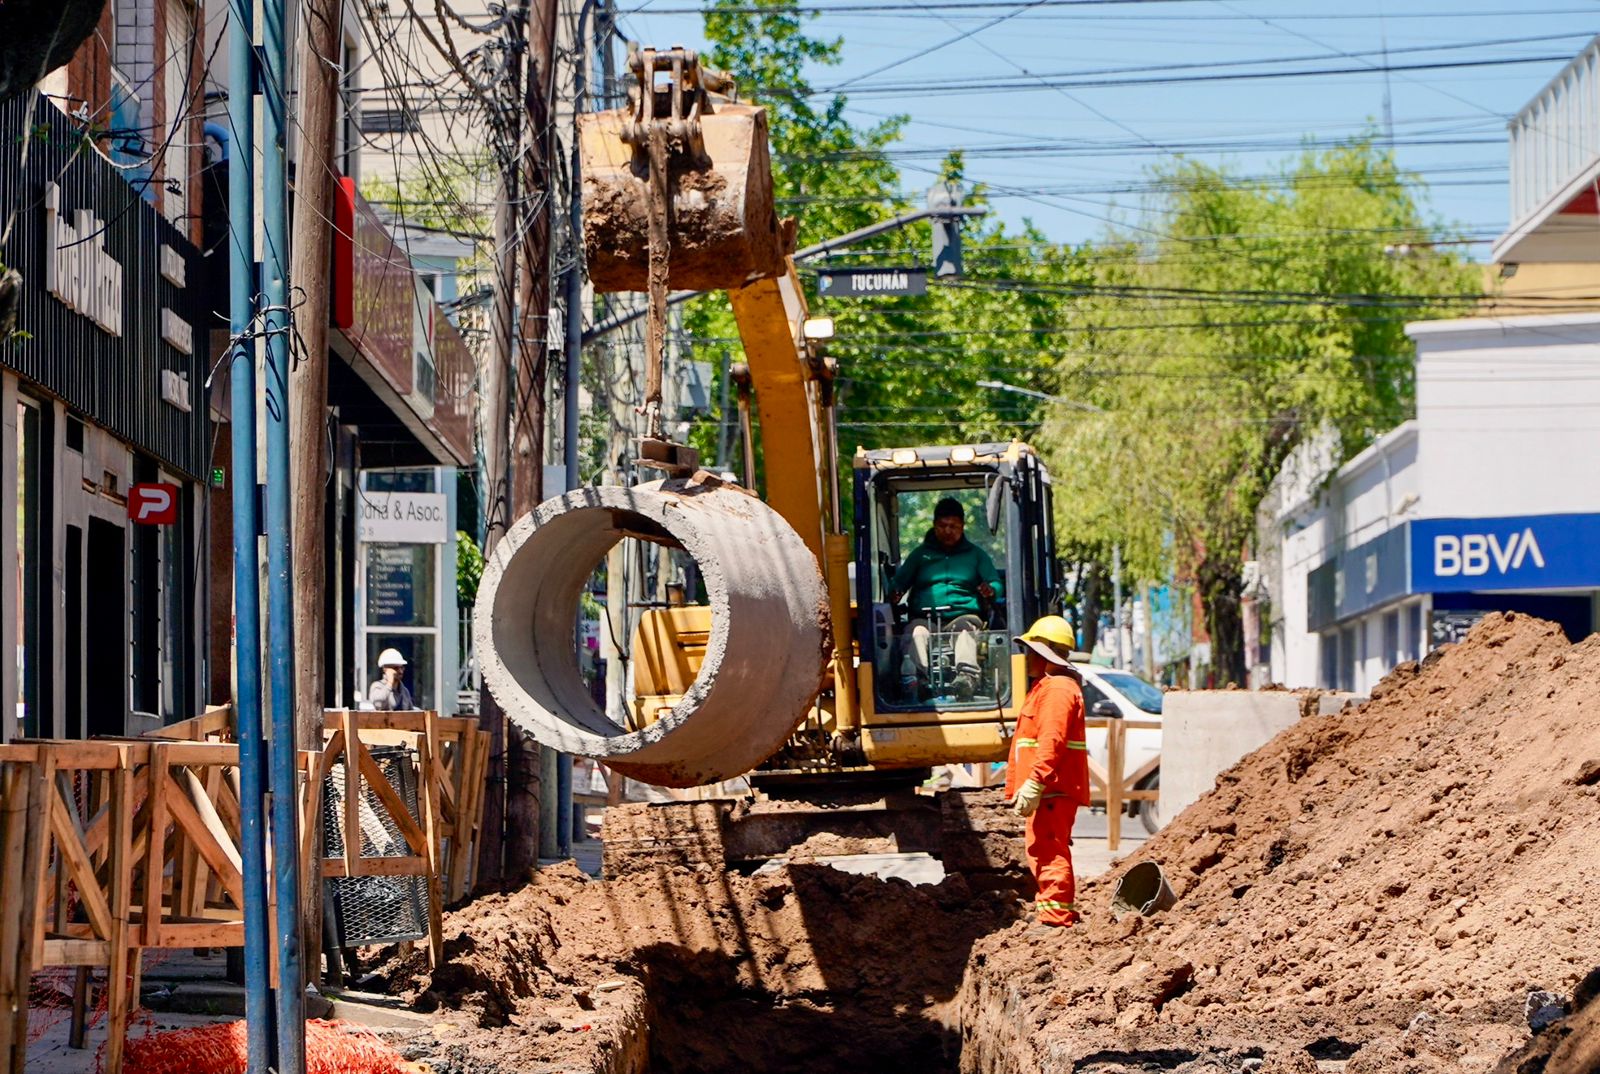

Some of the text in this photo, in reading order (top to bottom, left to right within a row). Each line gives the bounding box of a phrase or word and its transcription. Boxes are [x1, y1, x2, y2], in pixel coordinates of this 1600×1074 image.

[851, 270, 908, 291] TUCUMÁN
[394, 500, 403, 520] &
[407, 500, 443, 521] Asoc.
[1434, 527, 1545, 577] BBVA
